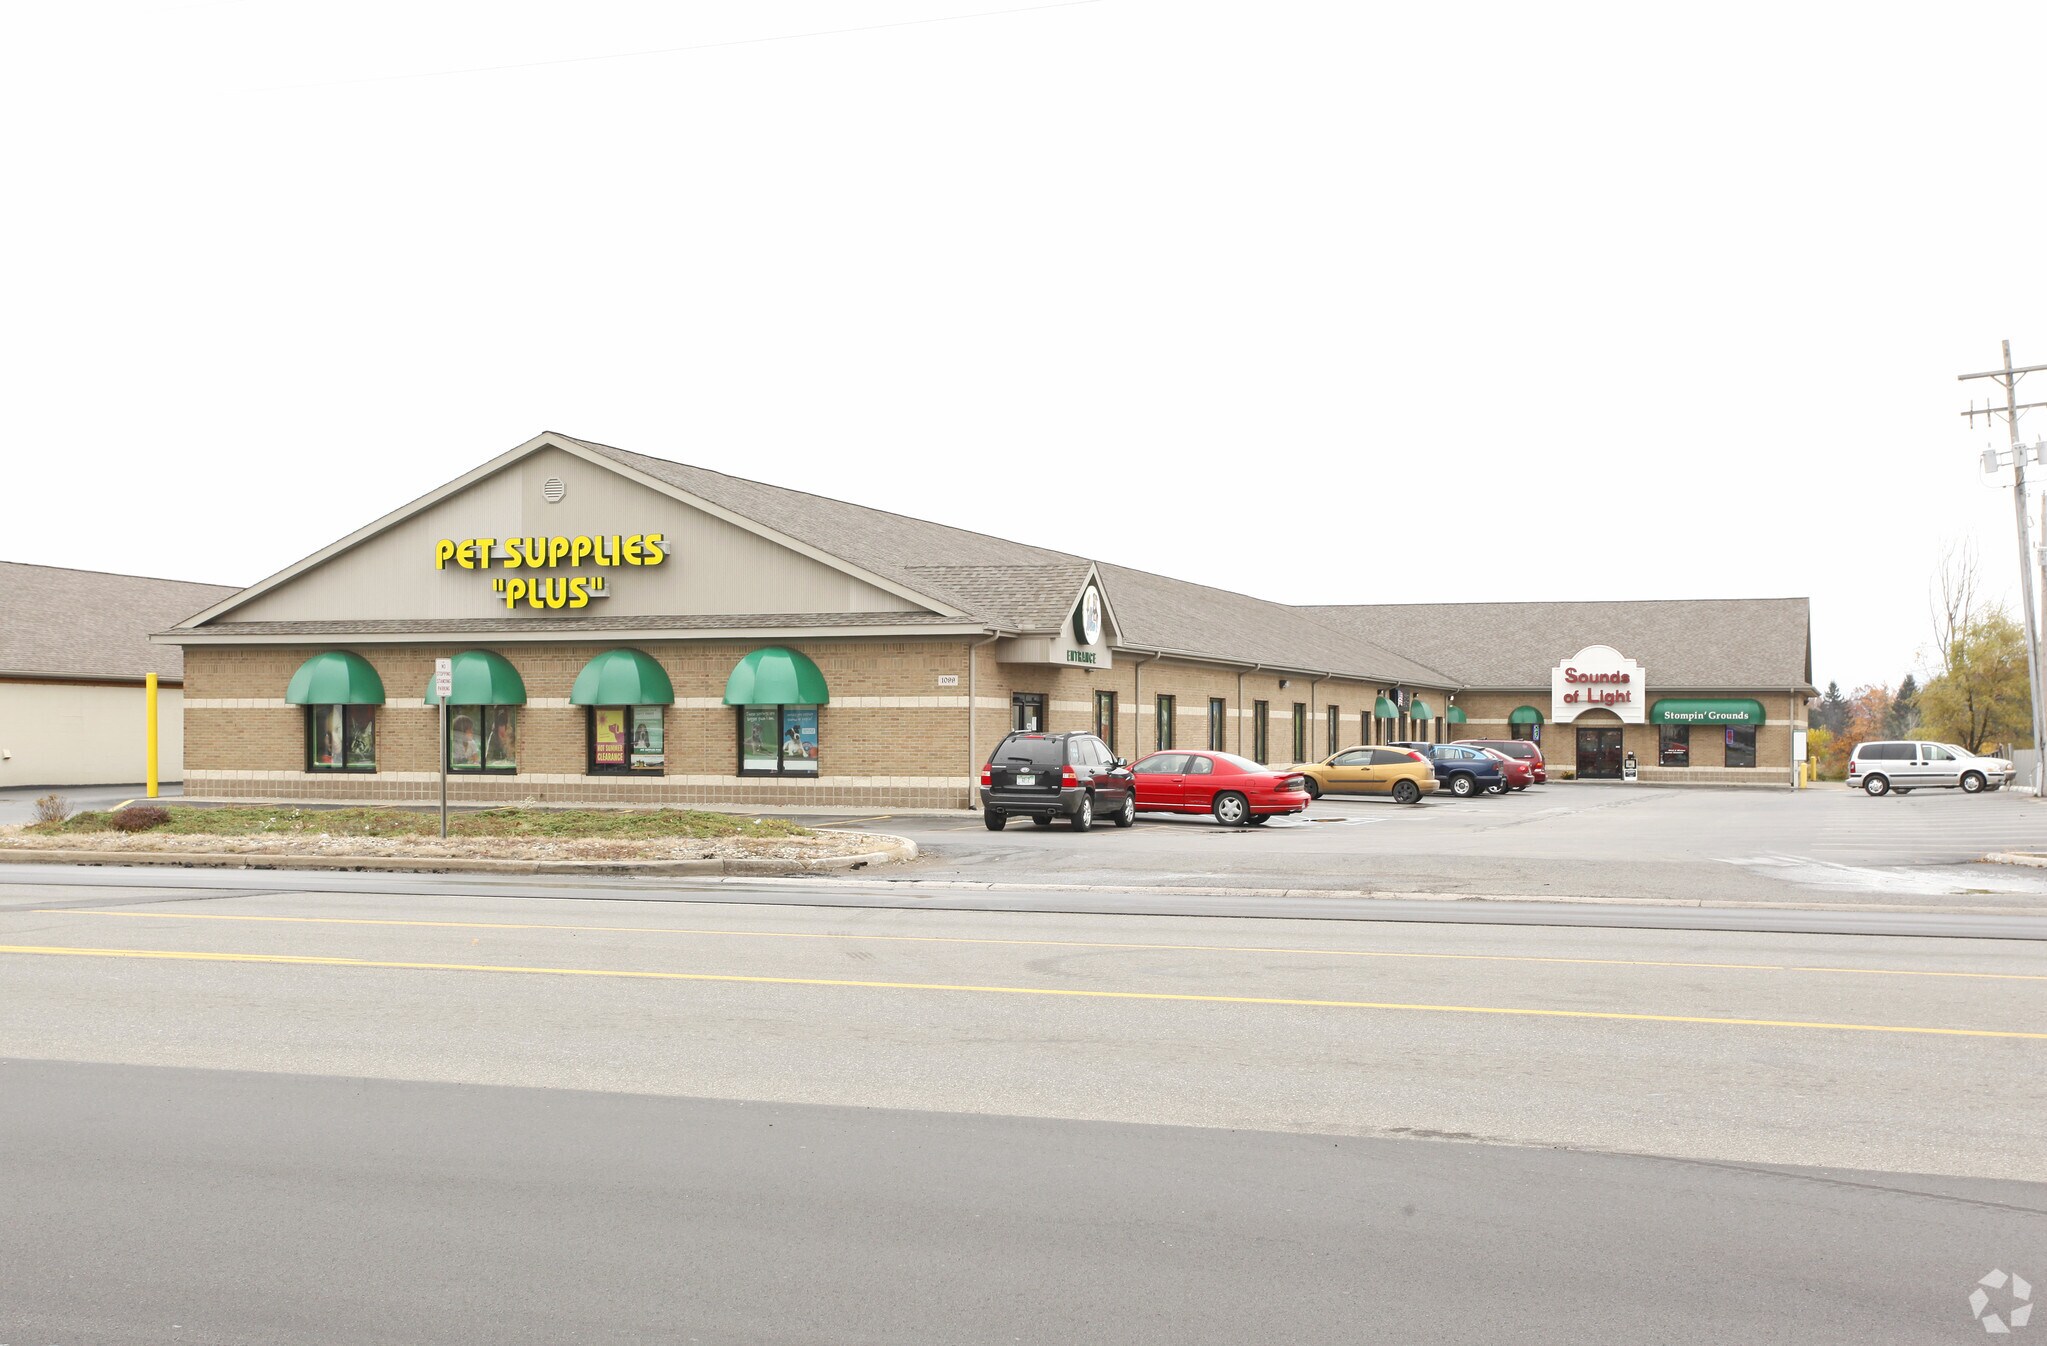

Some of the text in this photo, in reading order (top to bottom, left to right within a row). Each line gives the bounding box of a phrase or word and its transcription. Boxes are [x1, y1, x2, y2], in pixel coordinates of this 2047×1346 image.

[435, 533, 665, 570] PET SUPPLIES
[1066, 649, 1097, 664] ENTRANCE
[1564, 667, 1630, 684] Sounds
[1563, 687, 1631, 706] of Light
[1664, 711, 1749, 721] Stompin' Grounds
